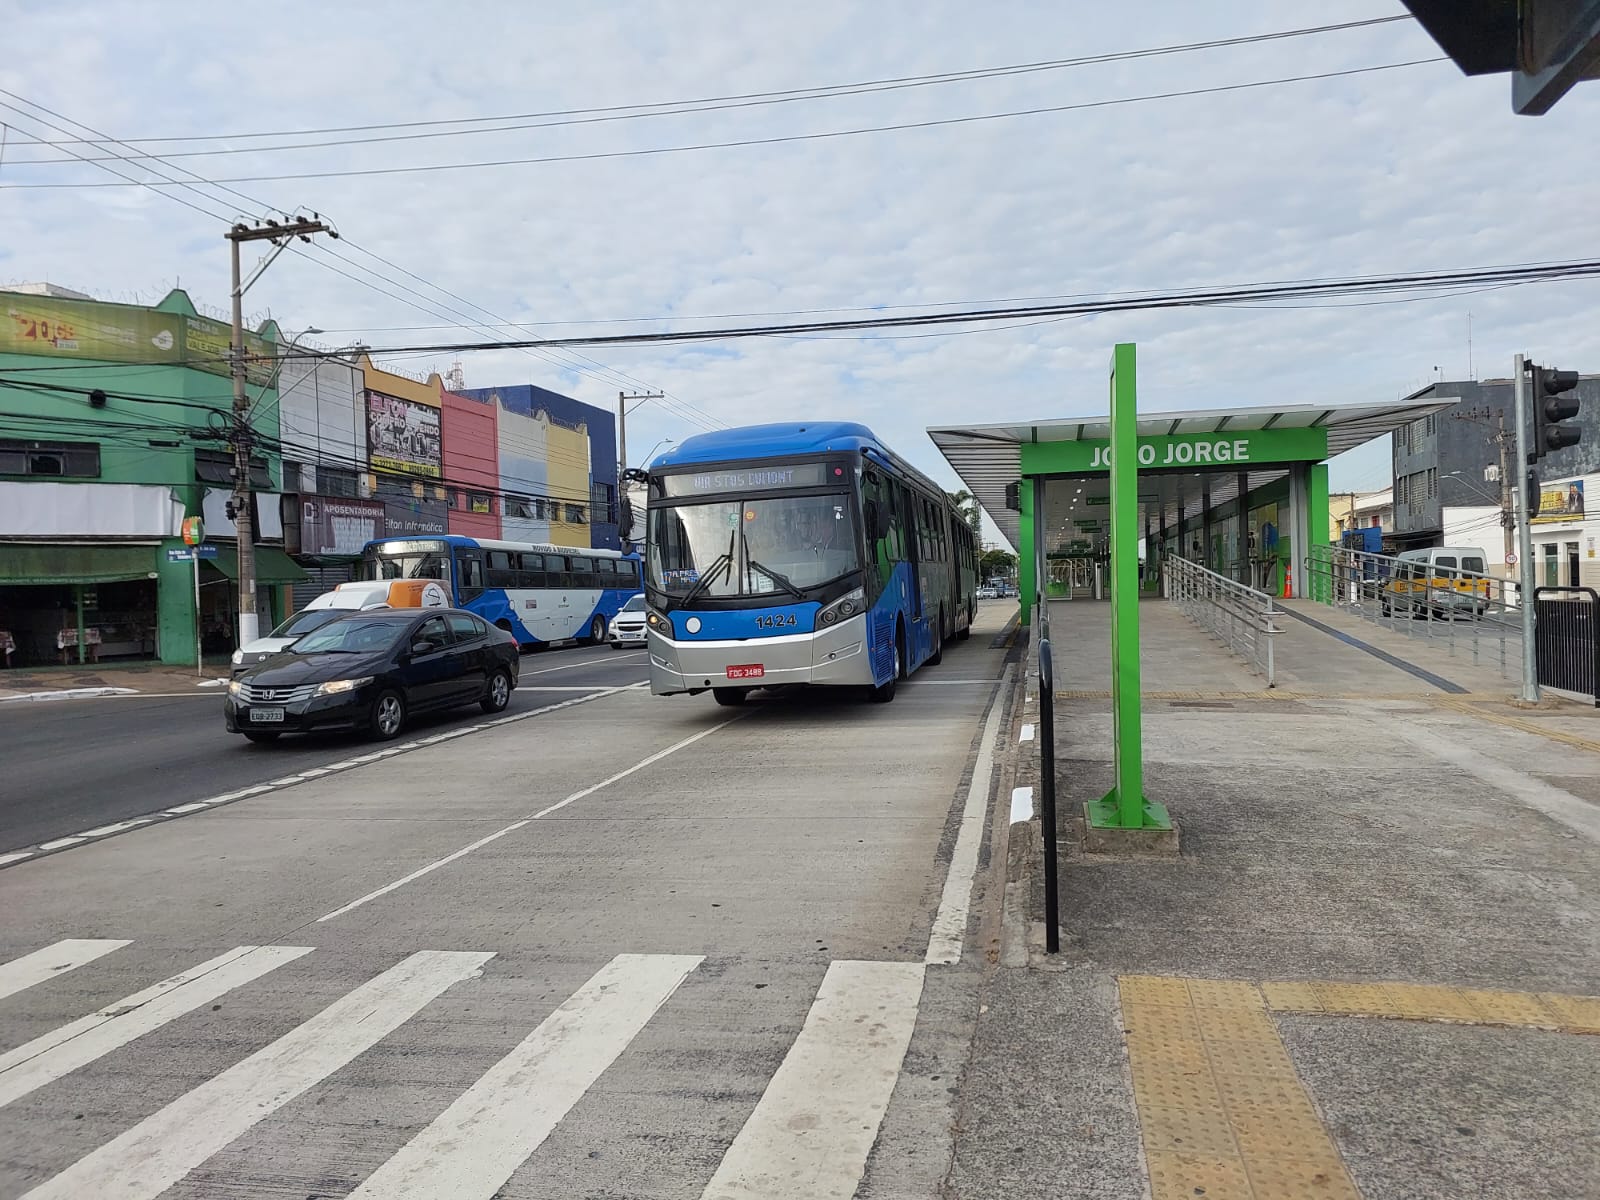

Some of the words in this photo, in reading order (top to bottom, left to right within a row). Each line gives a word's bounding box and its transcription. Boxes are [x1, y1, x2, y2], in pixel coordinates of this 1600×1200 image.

[370, 392, 408, 419] ELTON
[1163, 439, 1249, 464] JORGE
[324, 503, 385, 518] APOSENTADORIA
[755, 614, 797, 629] 1424
